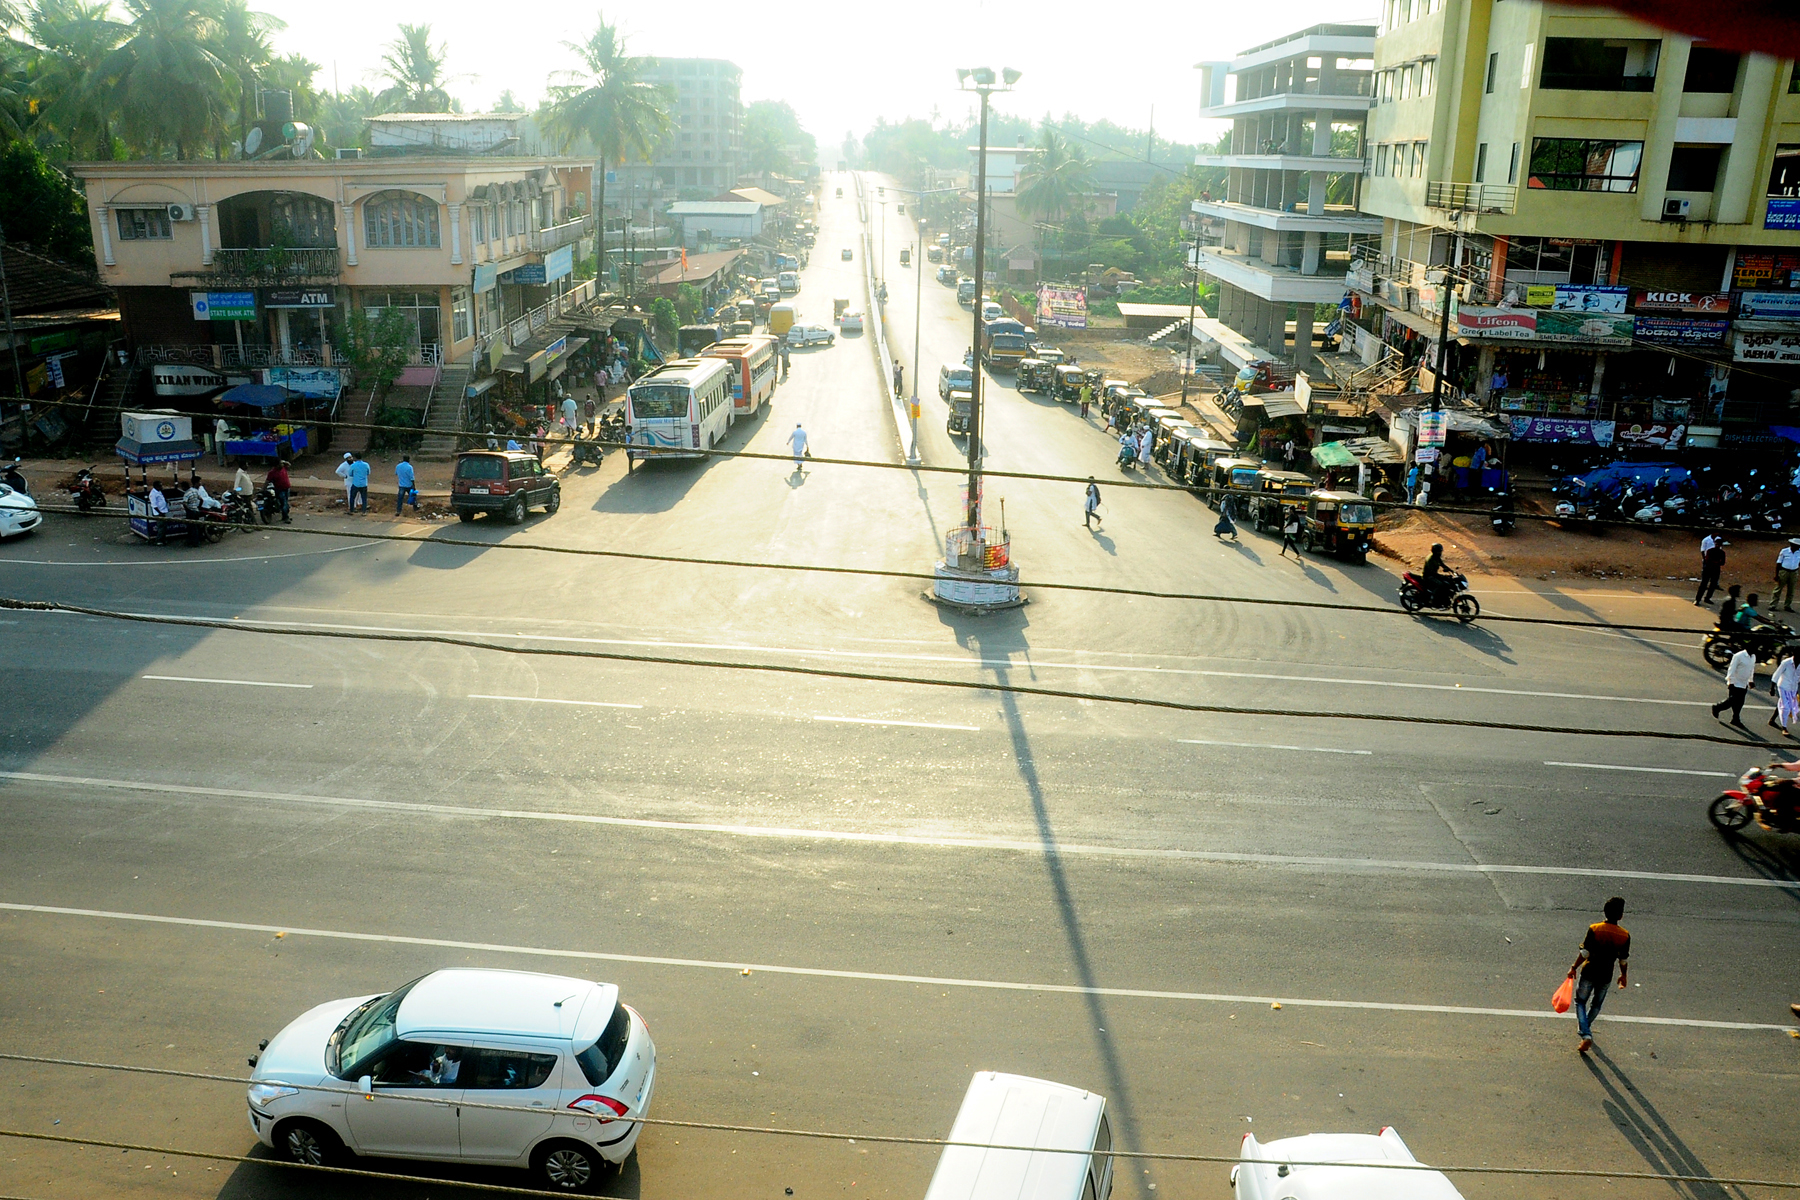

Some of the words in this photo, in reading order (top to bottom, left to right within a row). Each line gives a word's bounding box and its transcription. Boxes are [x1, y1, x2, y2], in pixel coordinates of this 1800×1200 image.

[1734, 268, 1770, 278] XEROX
[301, 293, 328, 304] ATM
[1646, 292, 1692, 303] KICK
[1461, 327, 1487, 336] Green
[1514, 330, 1530, 338] Tea
[1743, 349, 1778, 359] VAIBHAV
[154, 375, 191, 386] KIRAN
[191, 375, 228, 386] WINES
[1534, 422, 1552, 435] ಶ್ರೀ
[1725, 434, 1745, 442] DISHA
